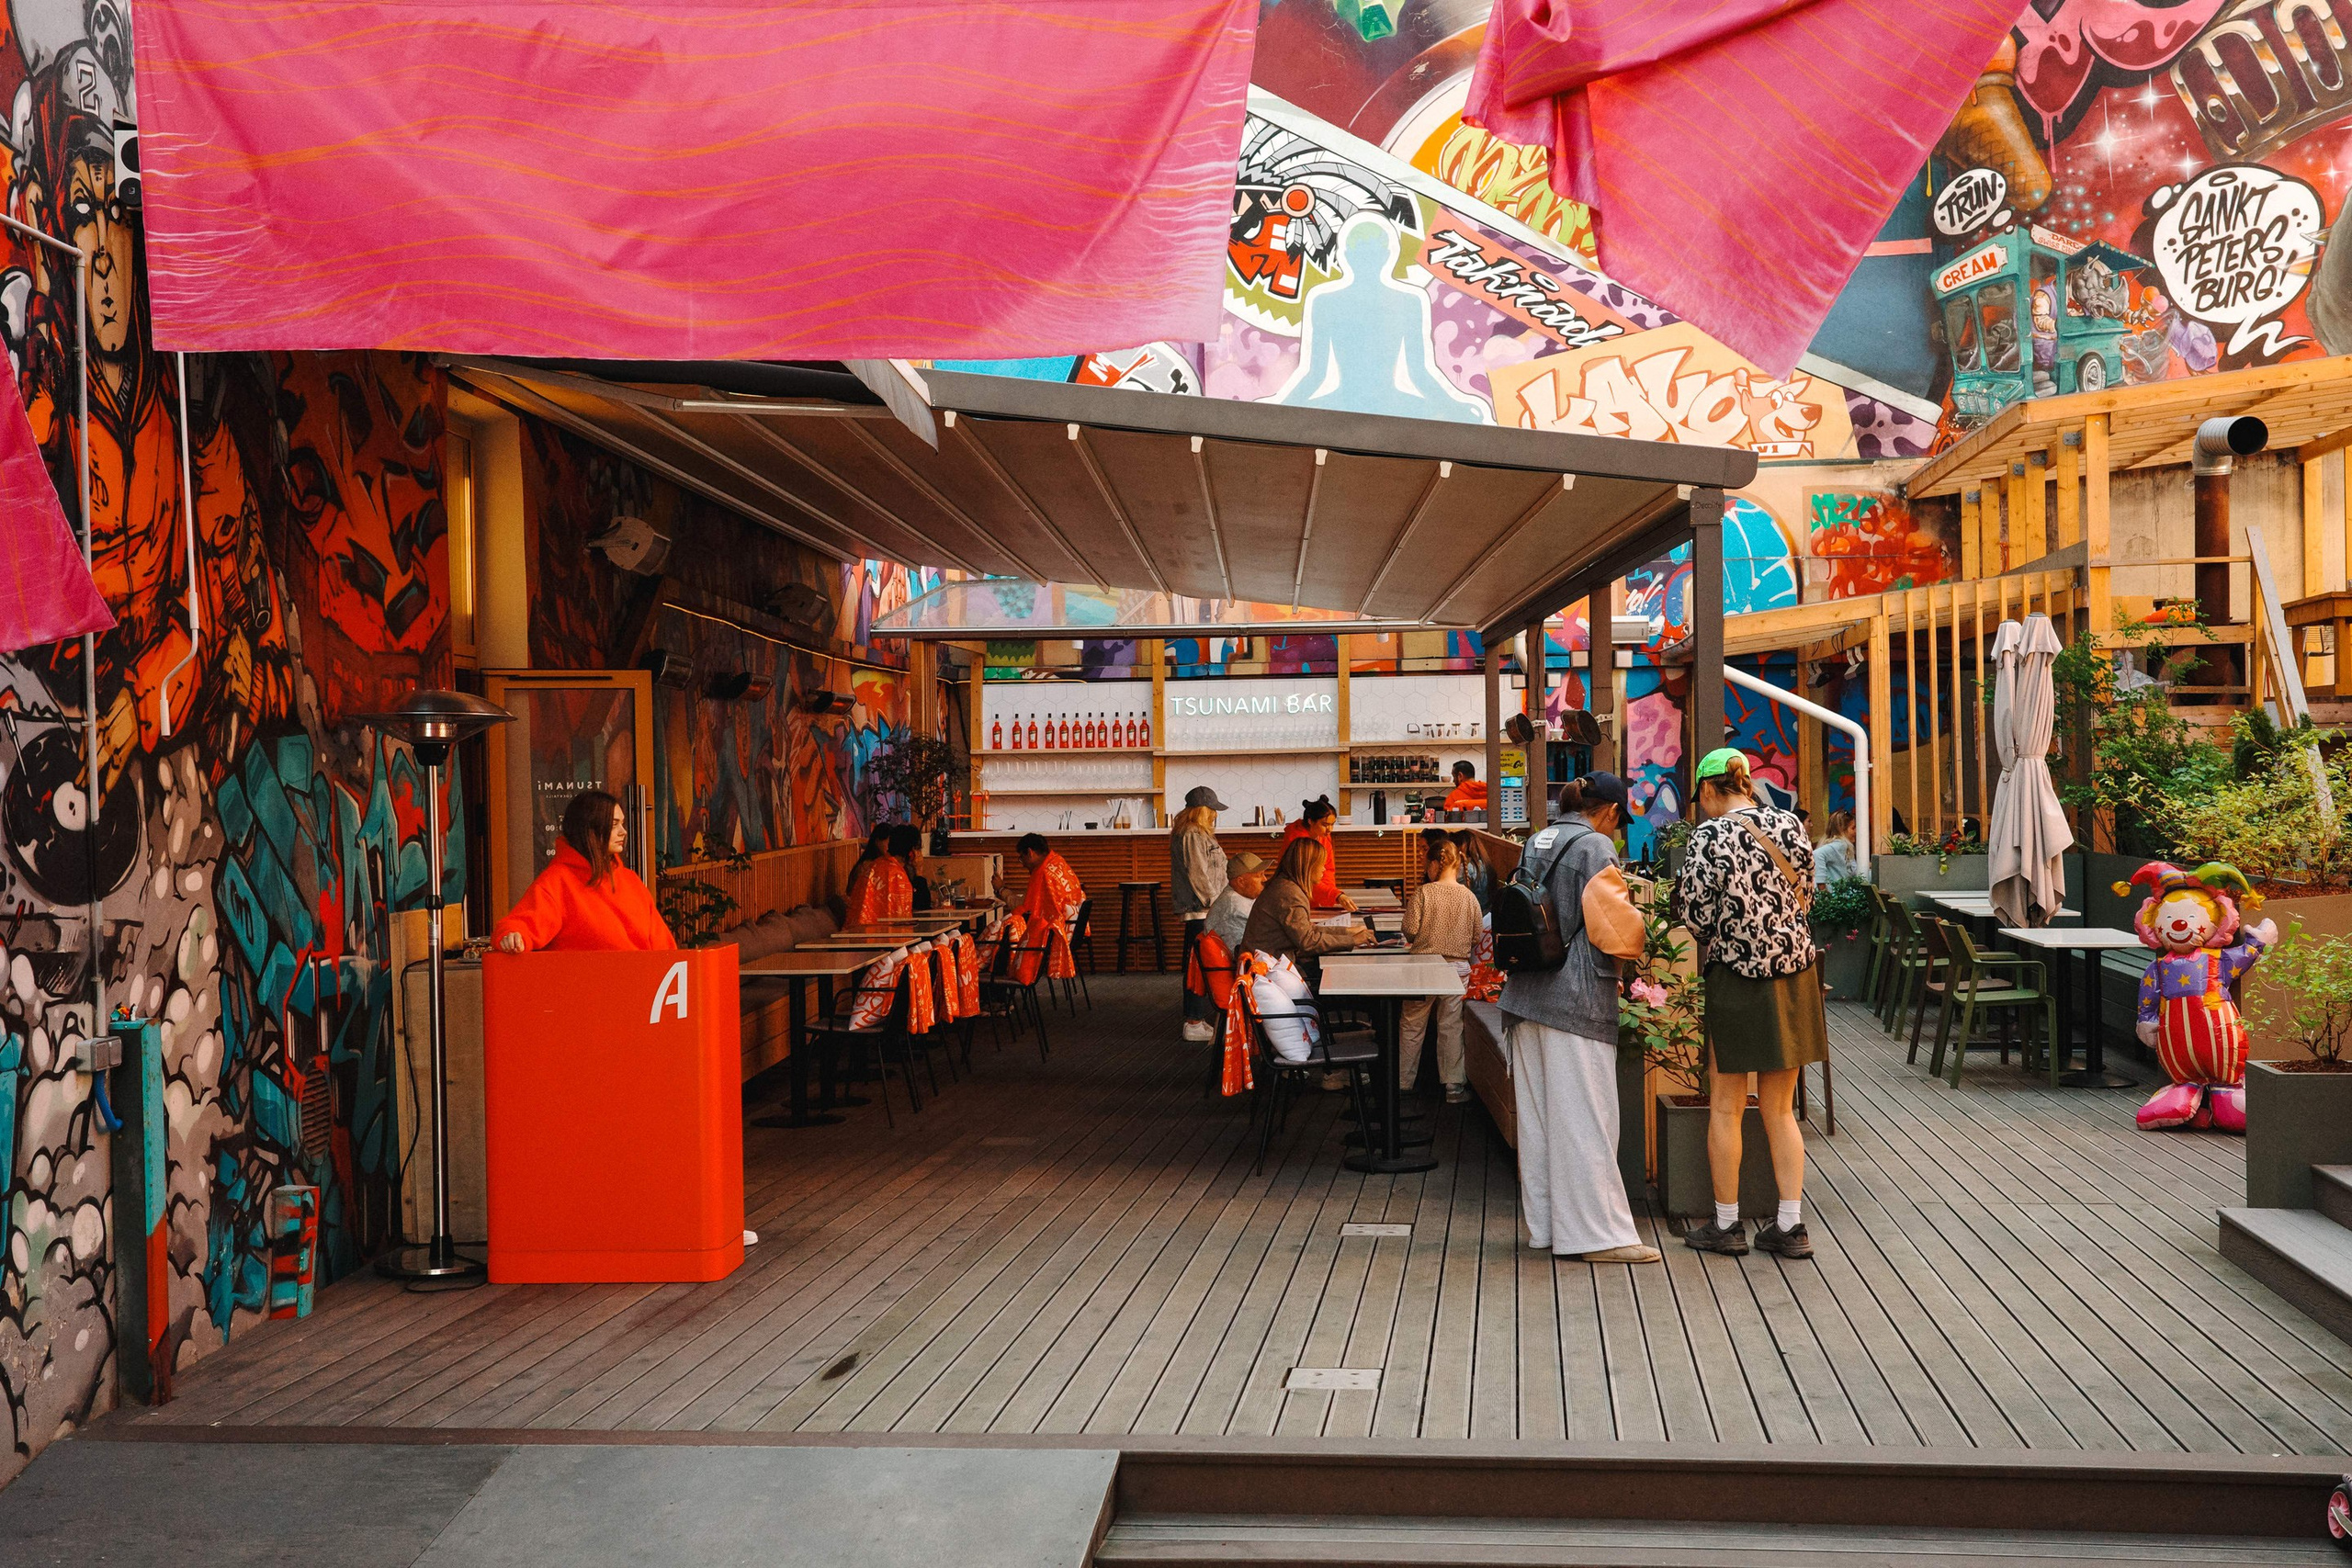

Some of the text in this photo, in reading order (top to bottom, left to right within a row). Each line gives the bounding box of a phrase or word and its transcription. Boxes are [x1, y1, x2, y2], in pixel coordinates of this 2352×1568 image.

[76, 60, 100, 118] 2
[1939, 173, 1996, 228] TRUN
[2178, 181, 2278, 245] SANKT
[1943, 252, 1998, 288] CREAM
[2175, 215, 2289, 284] PETERS
[2191, 250, 2299, 312] BURG!
[1170, 694, 1332, 716] TSUNAMI BAR
[650, 960, 688, 1024] A
